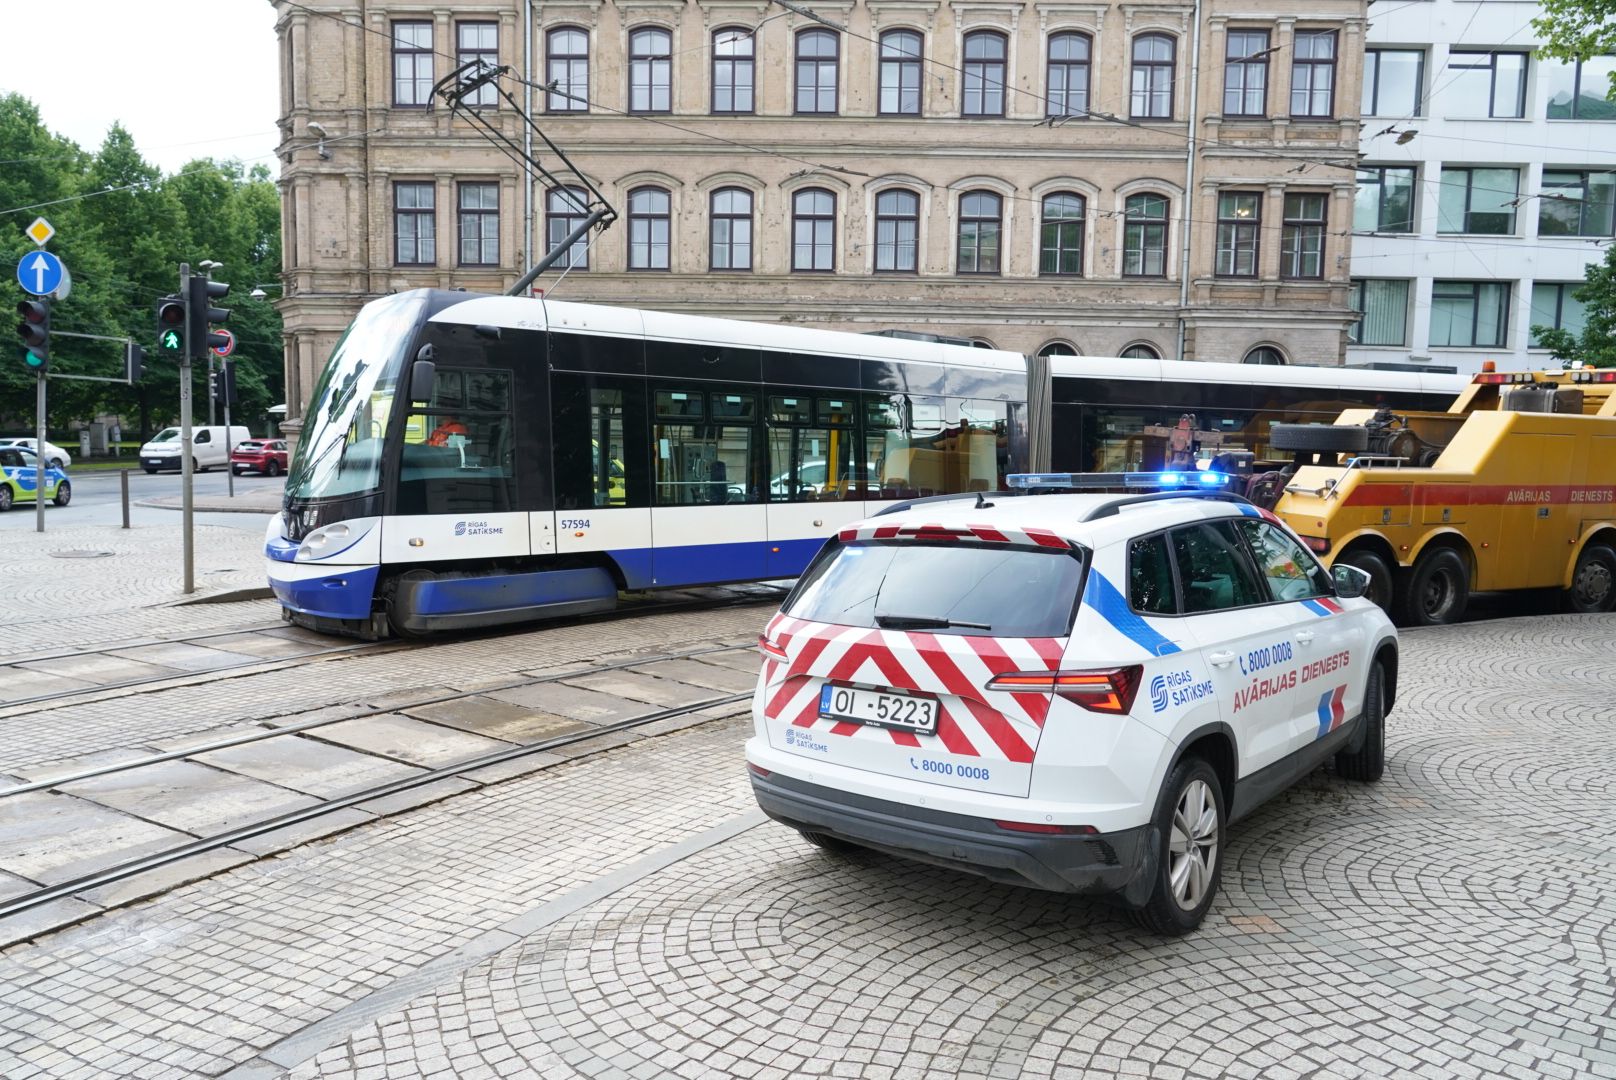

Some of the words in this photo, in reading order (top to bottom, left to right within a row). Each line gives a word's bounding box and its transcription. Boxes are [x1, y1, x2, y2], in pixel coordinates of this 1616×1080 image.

[1507, 489, 1551, 502] AVĀRIJAS
[1571, 490, 1613, 502] DIENESTS
[561, 519, 590, 529] 57594
[1249, 647, 1269, 673] 8000
[1273, 641, 1292, 665] 0008
[1233, 670, 1297, 714] AVĀRIJAS
[1302, 650, 1350, 684] DIENESTS
[821, 701, 830, 709] LV
[922, 758, 952, 775] 8000
[956, 765, 990, 781] 0008
